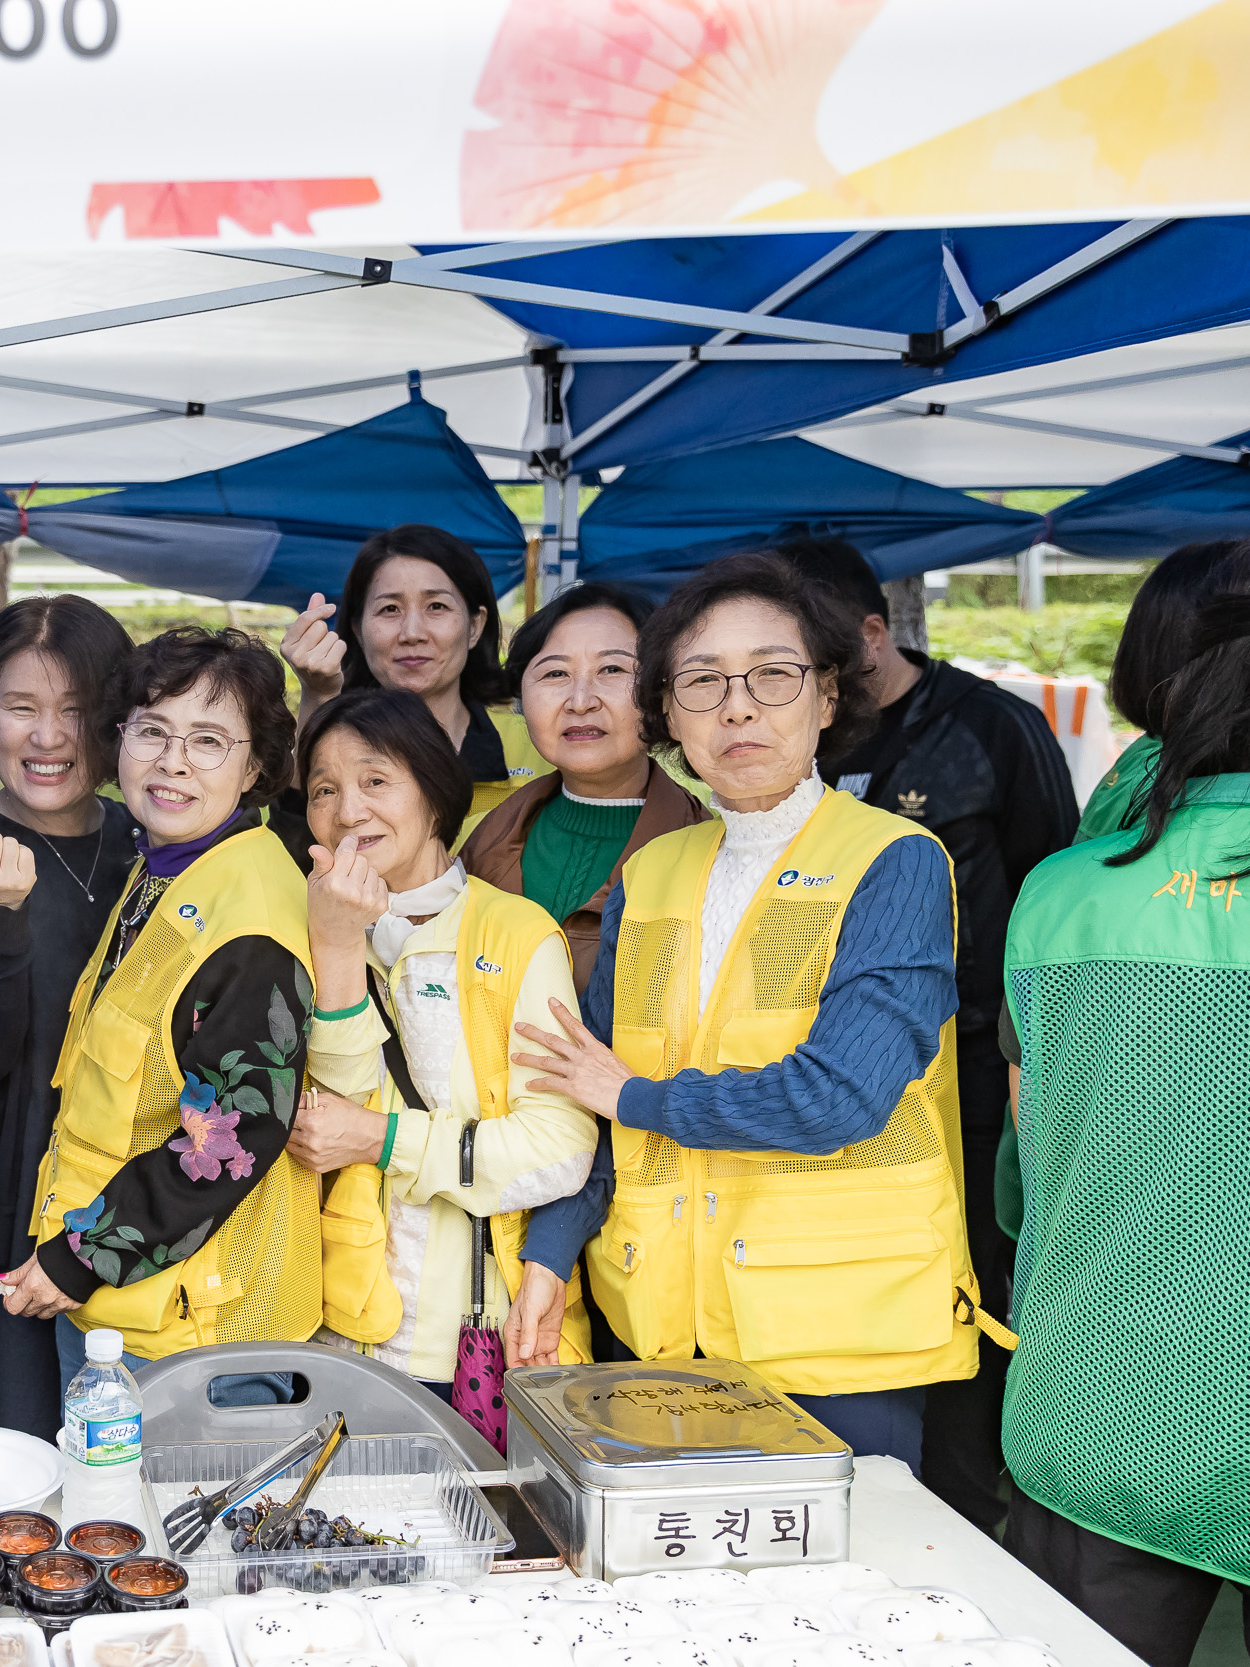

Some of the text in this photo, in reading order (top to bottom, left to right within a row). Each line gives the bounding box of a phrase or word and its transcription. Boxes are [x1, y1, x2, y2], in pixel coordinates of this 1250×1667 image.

[1152, 869, 1242, 912] 새마
[416, 990, 451, 1001] TRESPASS
[640, 1398, 783, 1416] 감사합니다
[107, 1423, 137, 1440] 삼다수
[654, 1504, 810, 1558] 통친회
